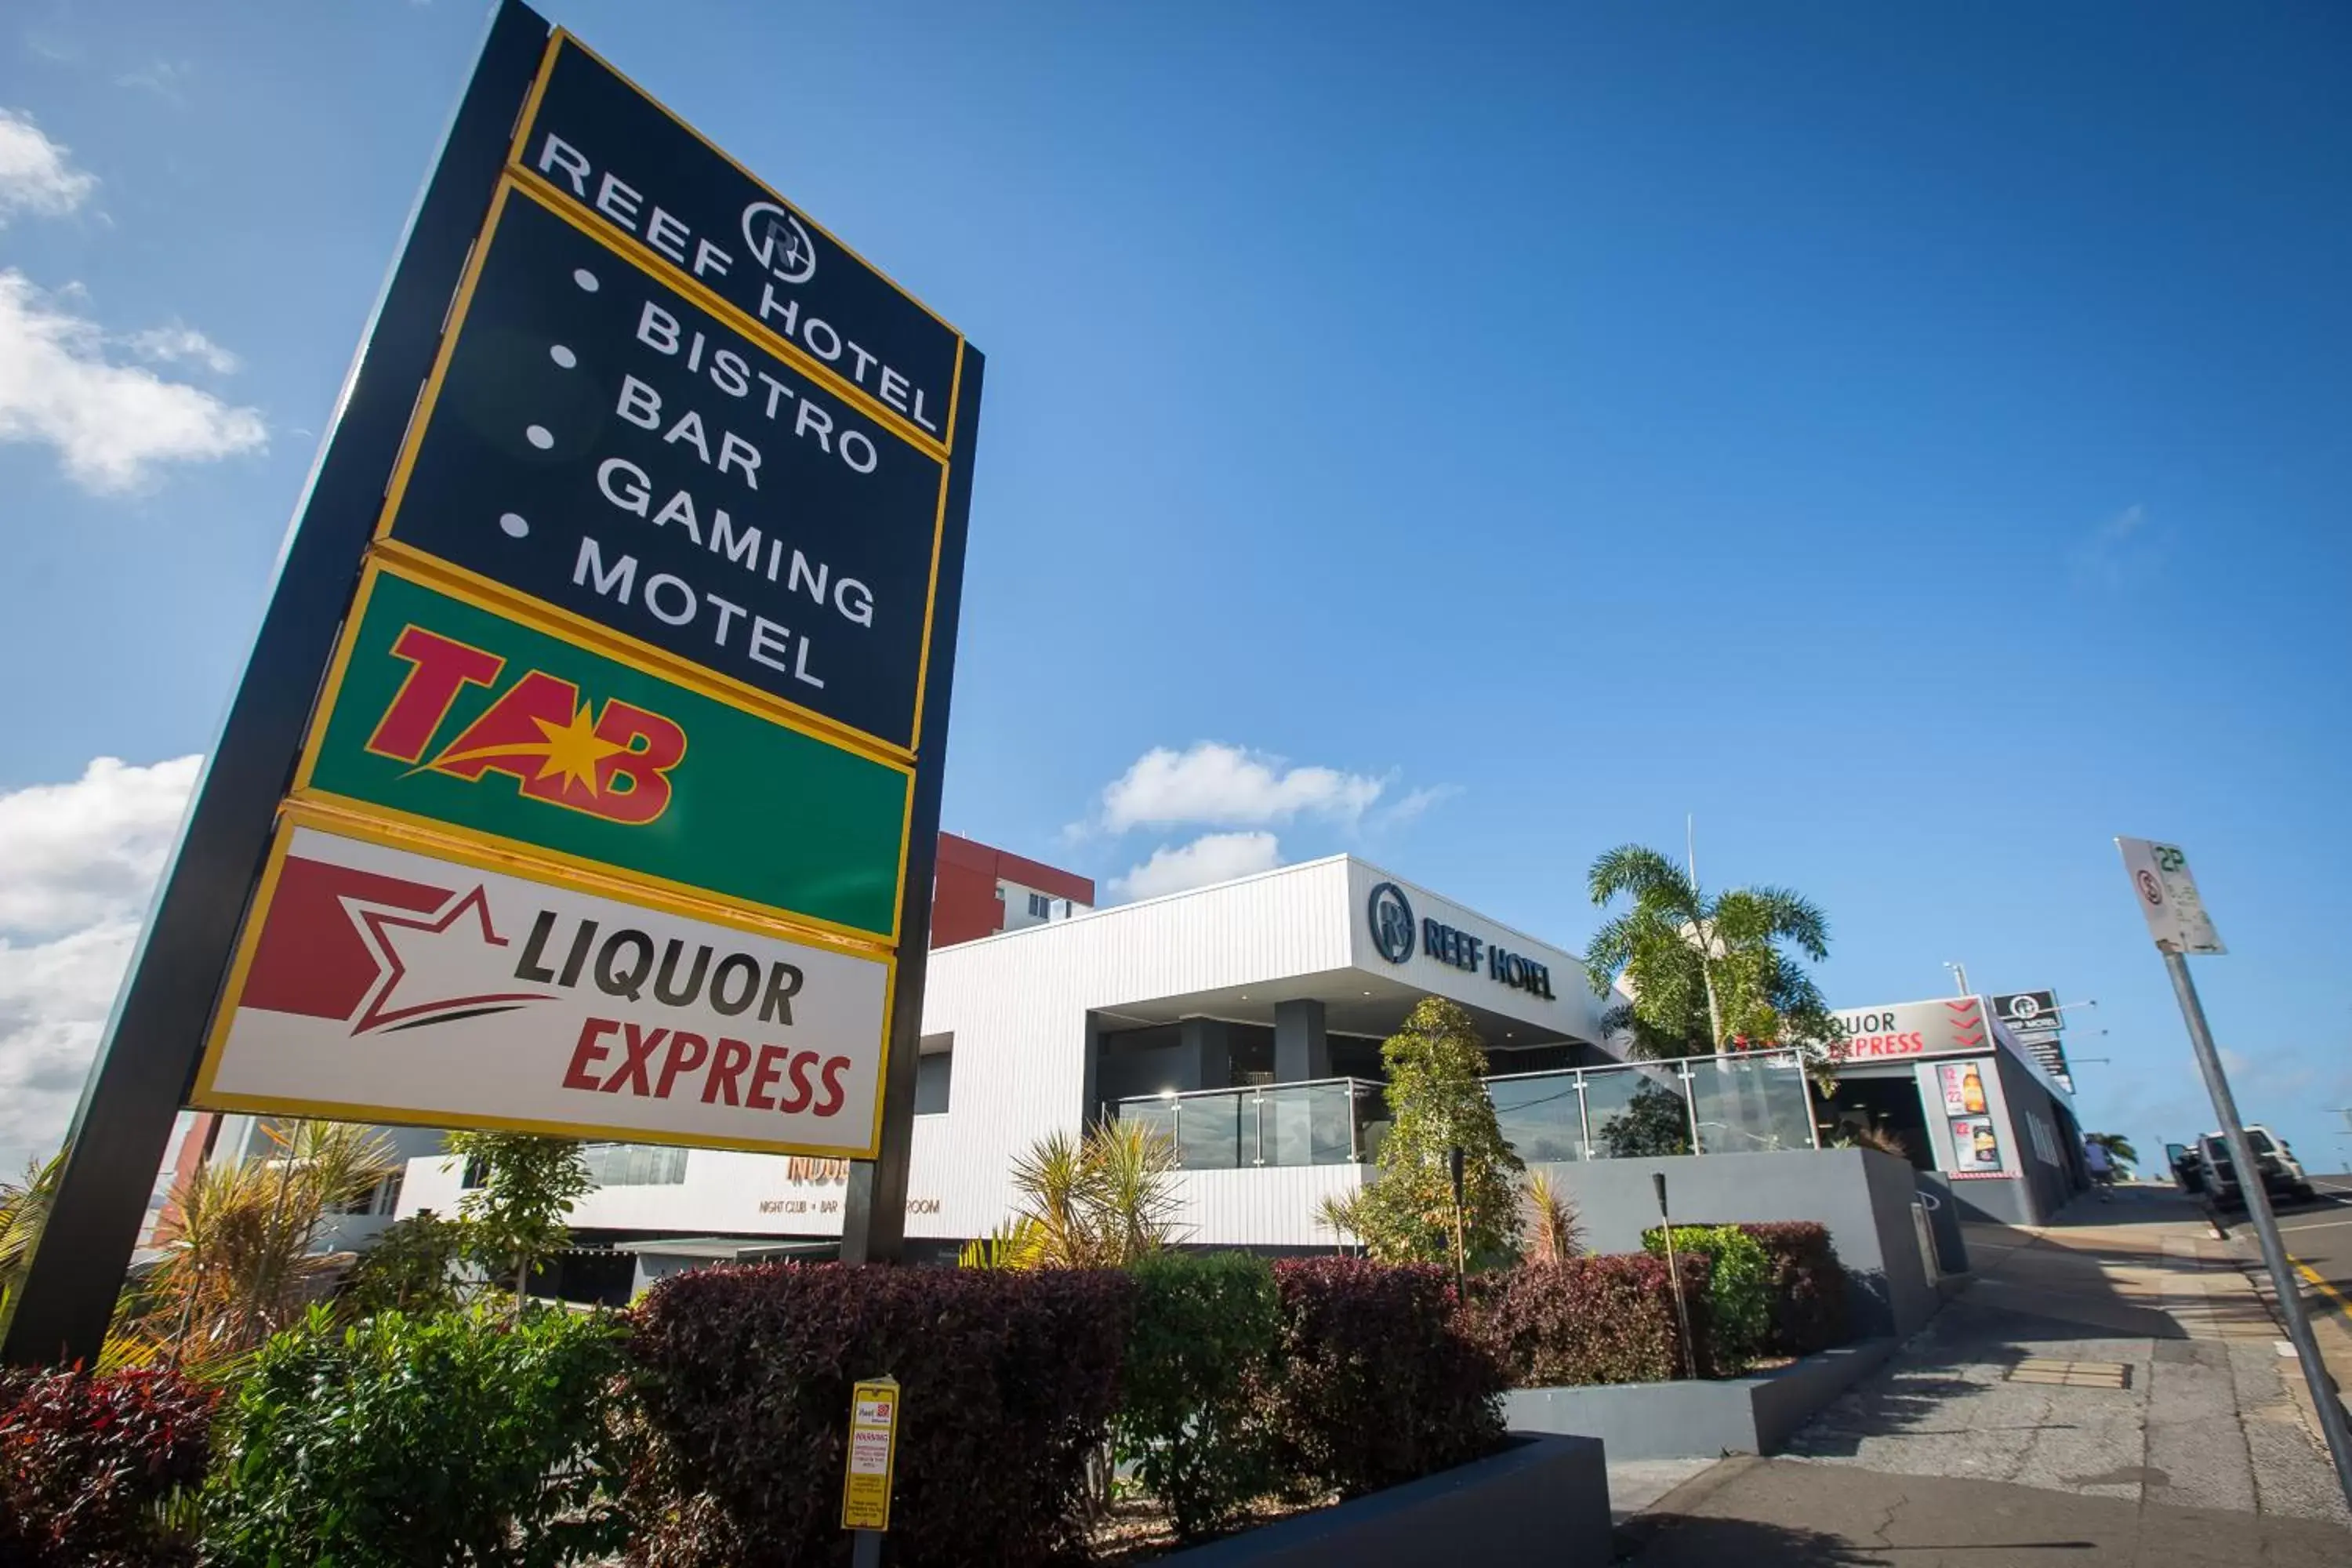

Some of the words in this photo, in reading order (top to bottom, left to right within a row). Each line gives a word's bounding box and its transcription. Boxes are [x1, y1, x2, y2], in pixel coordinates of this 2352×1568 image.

[539, 132, 733, 278] REEF
[758, 283, 937, 433] HOTEL
[615, 373, 762, 490] BAR
[635, 300, 877, 474] BISTRO
[596, 457, 874, 628] GAMING
[572, 535, 825, 689] MOTEL
[364, 623, 688, 826] TAB
[513, 910, 804, 1027] LIQUOR
[1422, 916, 1484, 973] REEF
[1489, 944, 1557, 1001] HOTEL
[1829, 1012, 1895, 1035] QUOR
[561, 1017, 852, 1118] EXPRESS
